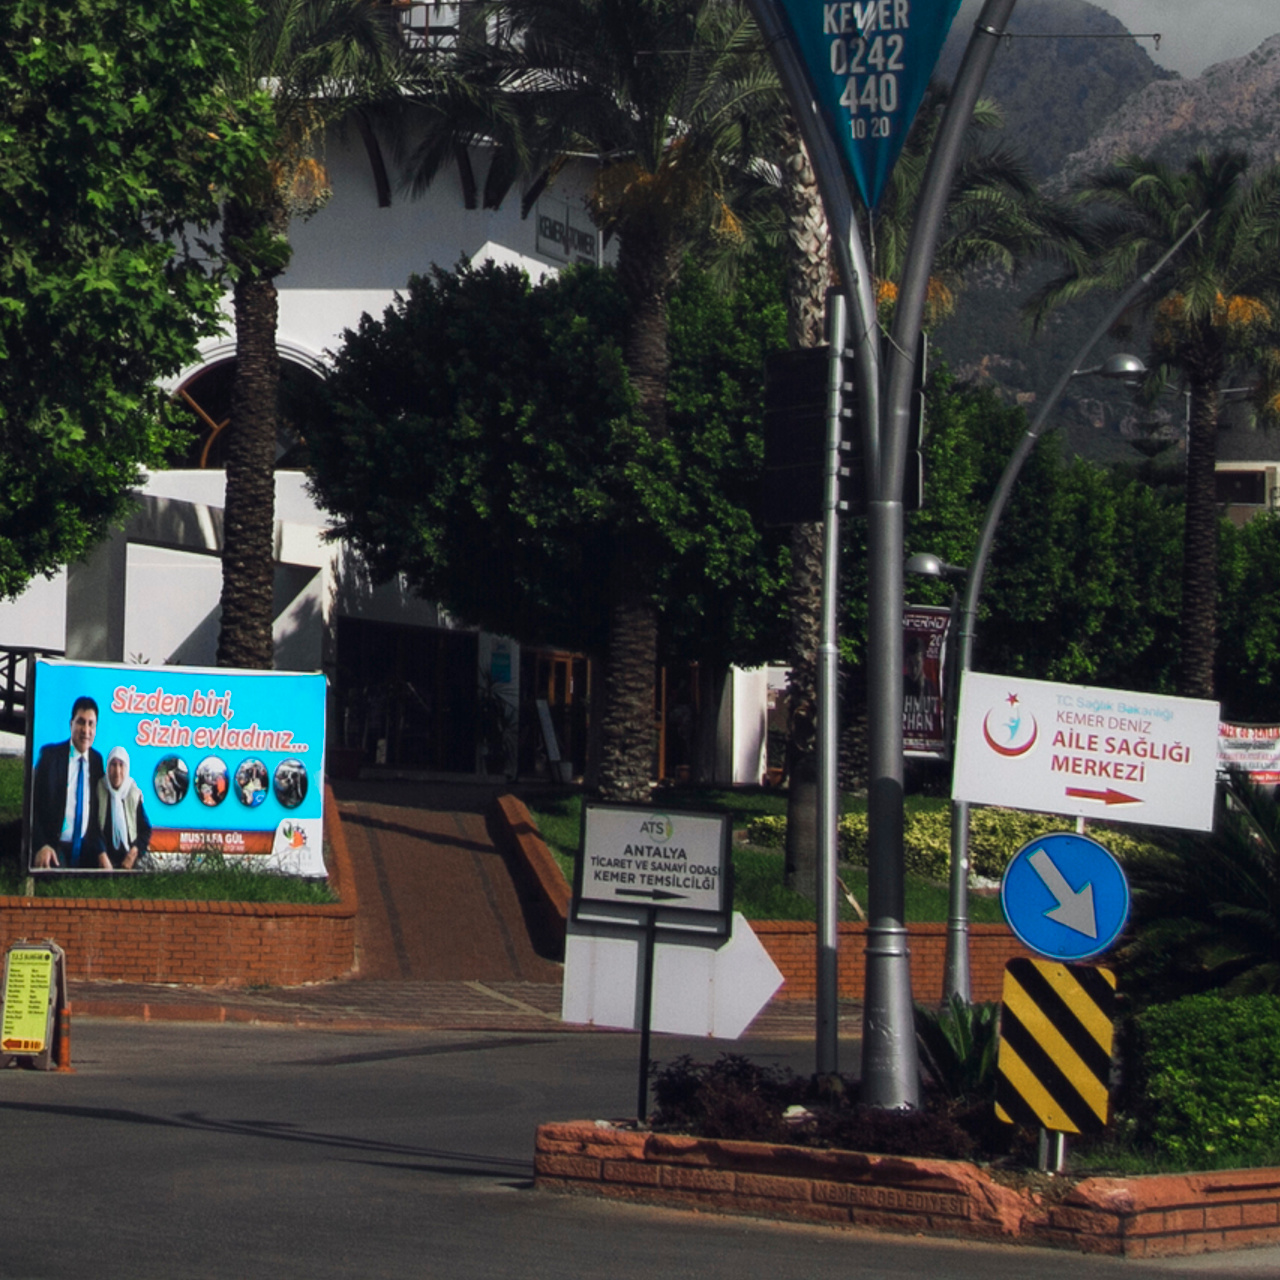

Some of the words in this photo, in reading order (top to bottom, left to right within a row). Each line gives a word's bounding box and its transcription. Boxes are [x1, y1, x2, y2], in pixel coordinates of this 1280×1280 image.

[830, 34, 904, 75] 0242
[839, 73, 897, 114] 440
[849, 118, 866, 139] 10
[871, 116, 890, 138] 20
[111, 685, 189, 715] Sizden
[191, 689, 234, 721] biri,
[136, 718, 191, 747] Sizin
[194, 722, 309, 752] evladınız...
[1056, 710, 1104, 728] KEMER
[1108, 715, 1152, 734] DENİZ
[1052, 728, 1099, 752] AİLE
[1104, 736, 1191, 764] SAĞLIĞI
[1051, 754, 1145, 782] MERKEZİ
[590, 855, 632, 869] TİCARET
[635, 860, 648, 871] VE
[651, 860, 687, 873] SANAYİ
[623, 844, 687, 860] ANTALYA
[593, 869, 635, 884] KEMER
